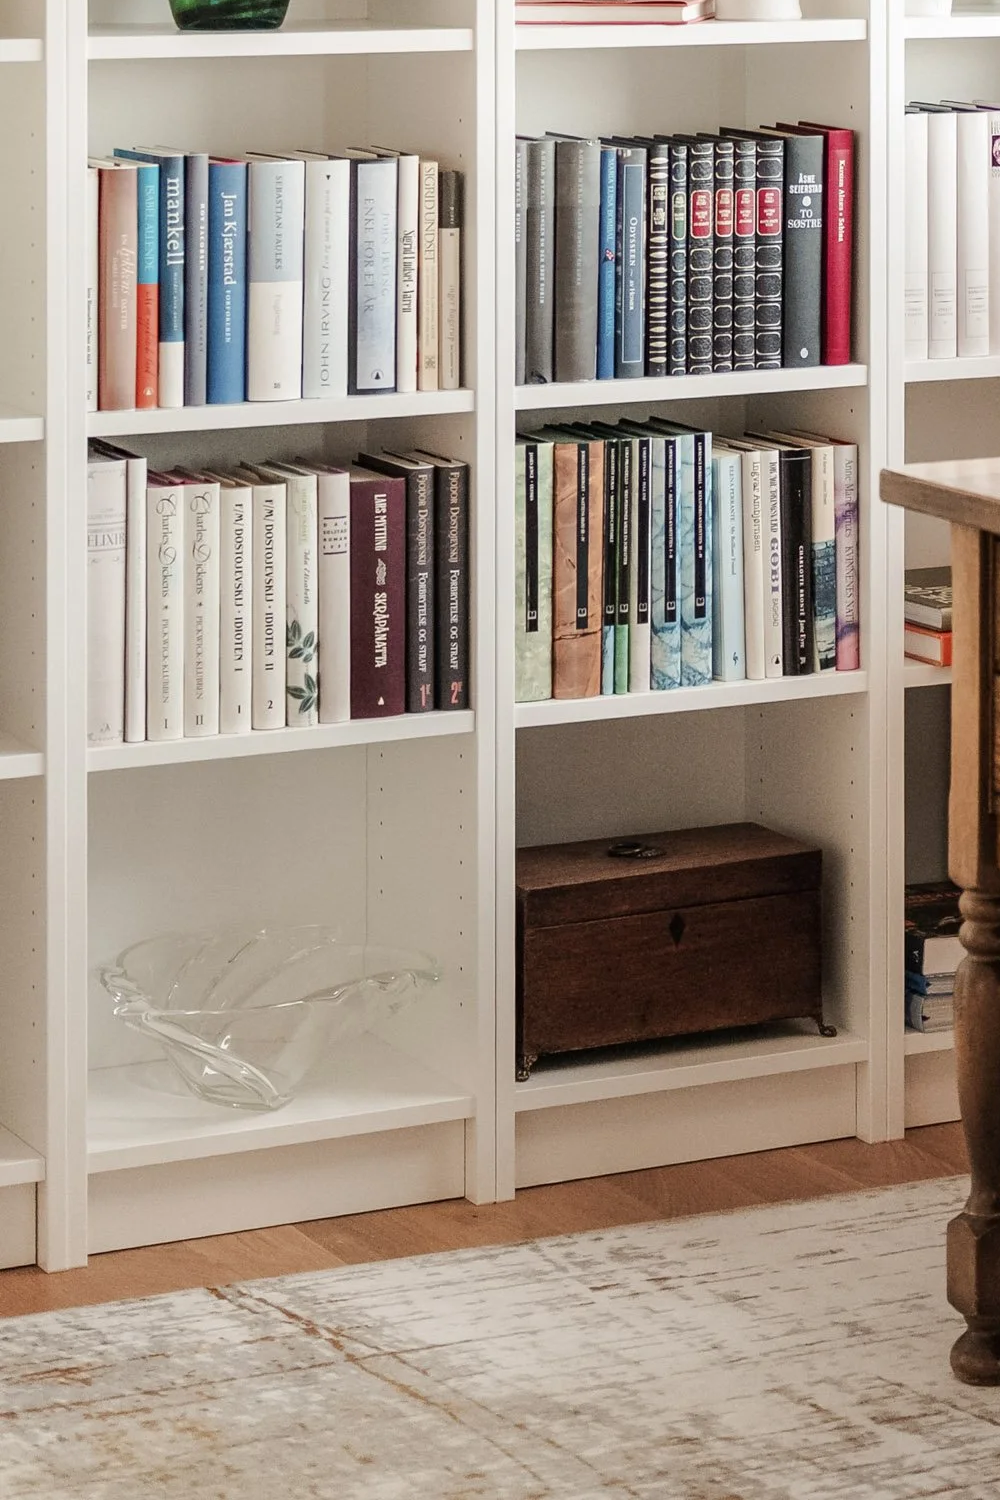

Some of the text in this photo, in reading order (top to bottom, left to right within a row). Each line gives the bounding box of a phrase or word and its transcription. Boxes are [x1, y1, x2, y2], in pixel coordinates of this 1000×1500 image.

[424, 167, 436, 210] SIGRID
[789, 184, 822, 194] SEIERSTAD
[798, 172, 815, 184] ÅSNE
[166, 177, 184, 266] mankell
[221, 192, 237, 217] Jan
[275, 175, 283, 270] SEBASTIAN FAULKS
[787, 219, 822, 229] SØSTRE
[800, 209, 813, 218] TO
[144, 185, 155, 272] ISABEL ALLENDE
[402, 230, 416, 254] Sigrid
[424, 211, 436, 263] UNDSET
[629, 217, 639, 267] ODYSSEEN
[221, 220, 237, 285] Kjærstad
[363, 198, 376, 314] ENKE FOR ET ÅR
[382, 213, 392, 297] JOHN IRVING
[402, 257, 416, 283] Undset
[321, 277, 331, 337] IRVING
[321, 345, 331, 387] JOHN
[844, 459, 855, 481] Anne
[750, 461, 761, 552] Ingvar Ambjørnsen
[844, 483, 855, 507] Marie
[156, 493, 177, 598] Charles Dickens
[190, 491, 212, 595] Charles Dickens
[264, 524, 275, 603] DOSTOJEVSKIJ
[234, 528, 244, 608] DOSTOJEVSKIJ
[303, 567, 311, 605] Elisabeth
[372, 493, 390, 668] LARS MYTTING SKRÅPÅNATTA
[770, 538, 779, 595] GOBI
[844, 545, 855, 599] KVINNENES
[264, 612, 275, 657] IDIOTEN
[450, 626, 459, 640] OG
[844, 600, 855, 625] NATT
[234, 617, 244, 661] IDIOTEN
[418, 628, 427, 642] OG
[450, 642, 459, 670] STRAFF
[418, 644, 427, 673] STRAFF
